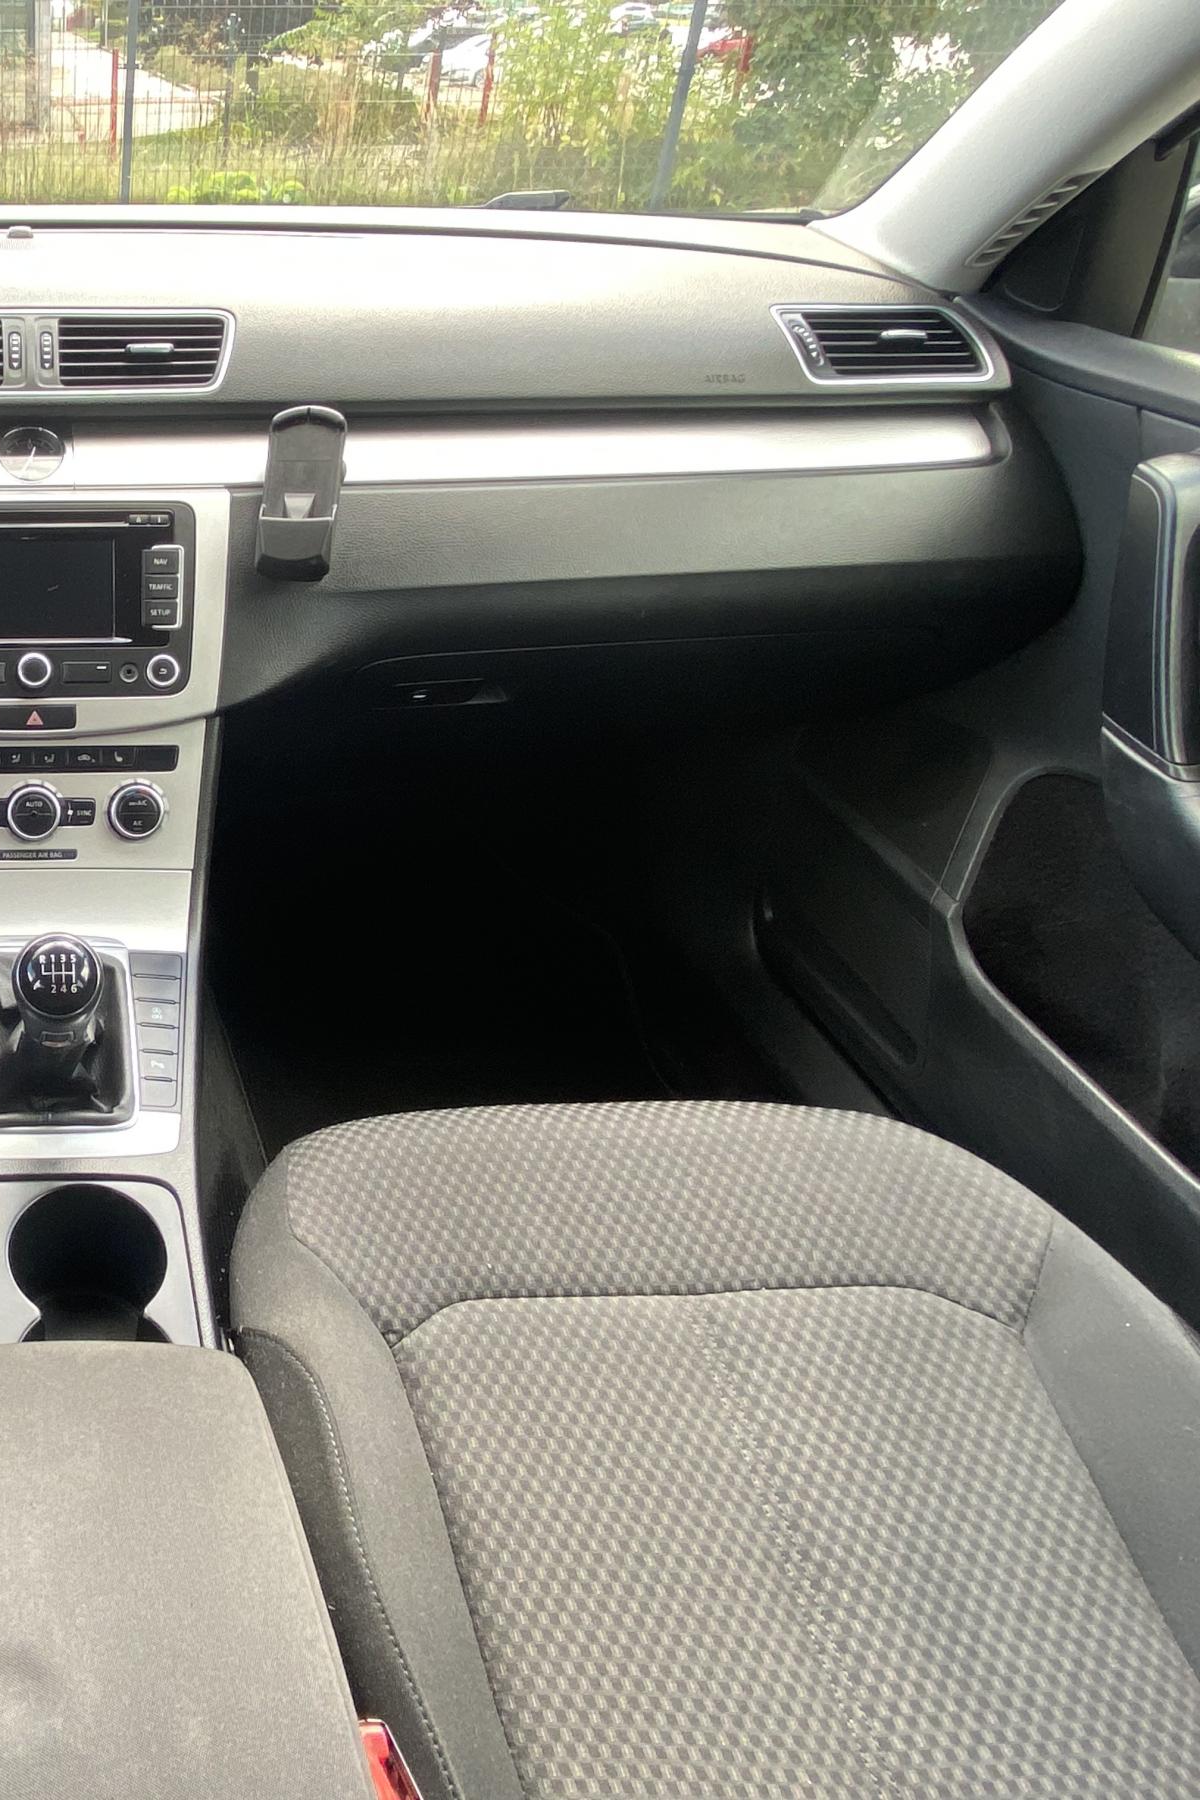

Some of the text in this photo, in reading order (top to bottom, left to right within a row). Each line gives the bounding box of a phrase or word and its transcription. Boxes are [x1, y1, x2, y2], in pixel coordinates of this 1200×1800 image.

[148, 583, 173, 591] TRAFFIC
[77, 809, 92, 817] SYNC
[2, 851, 37, 859] PASSENGER
[39, 953, 77, 964] R 1 3 5
[50, 984, 78, 994] 2 4 6
